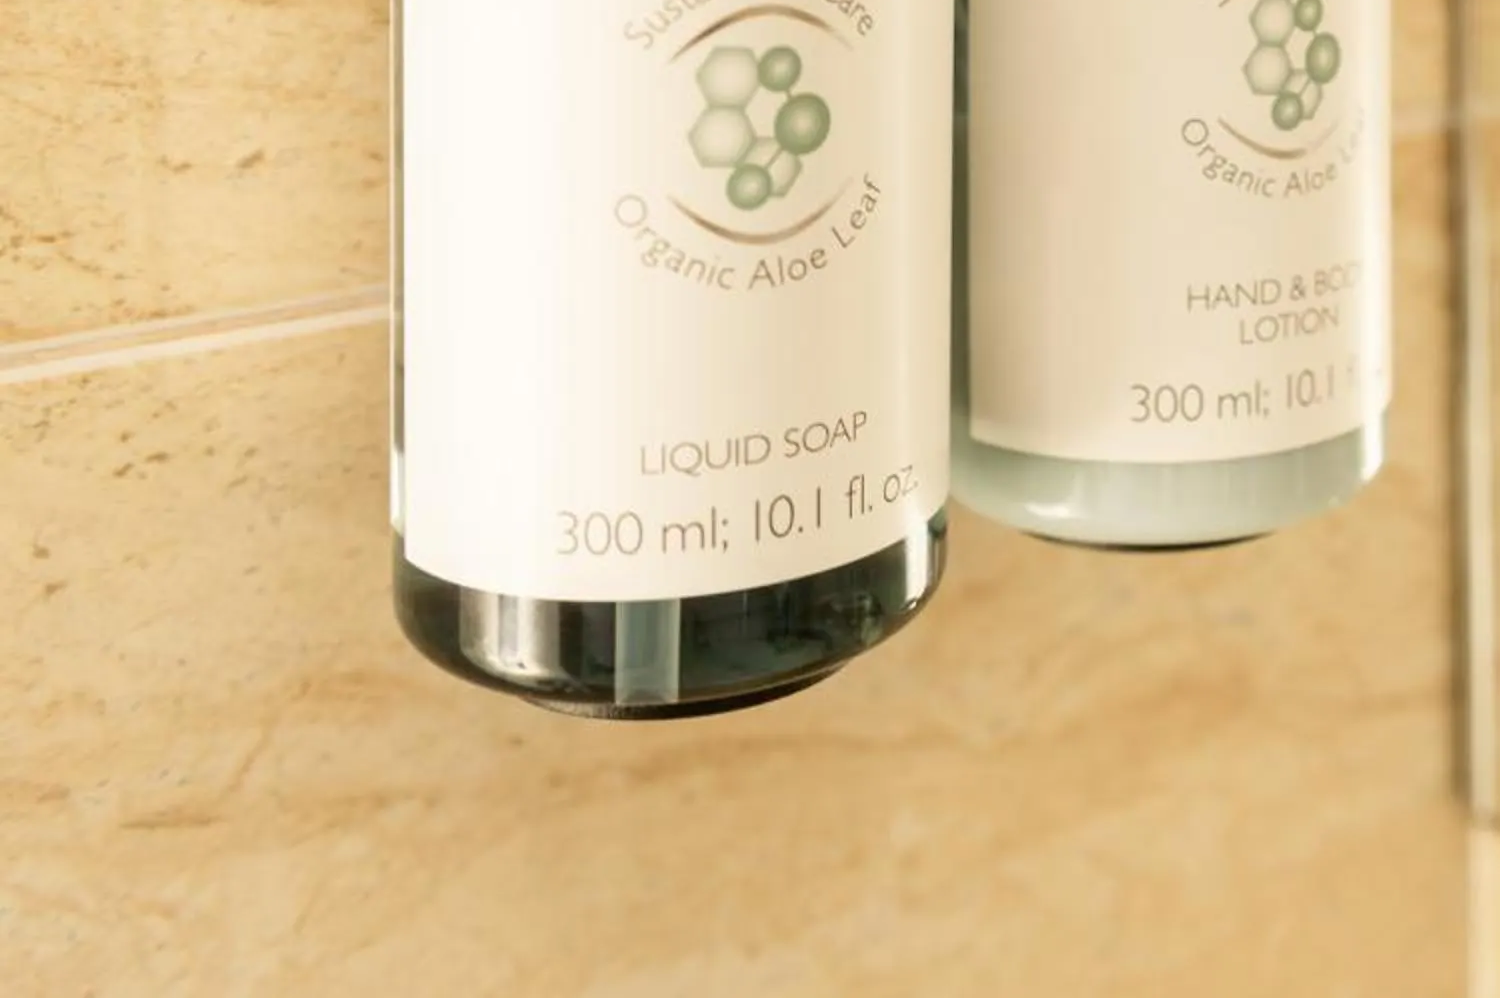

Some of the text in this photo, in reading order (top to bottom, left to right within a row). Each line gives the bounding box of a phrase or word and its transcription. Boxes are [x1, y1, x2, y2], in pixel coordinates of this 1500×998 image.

[1180, 117, 1276, 199] Organic
[1283, 162, 1338, 199] Aloe
[613, 172, 883, 291] Organic Aloe Leaf
[1186, 278, 1282, 313] HAND
[1289, 274, 1306, 301] &
[1239, 304, 1340, 345] LOTION
[1130, 383, 1205, 423] 300
[1216, 380, 1270, 420] ml;
[1286, 363, 1335, 410] 10.1
[639, 410, 869, 477] LIQUID SOAP
[556, 510, 644, 556] 300
[660, 507, 730, 554] ml;
[755, 486, 821, 542] 10.1
[845, 474, 873, 519] fl.
